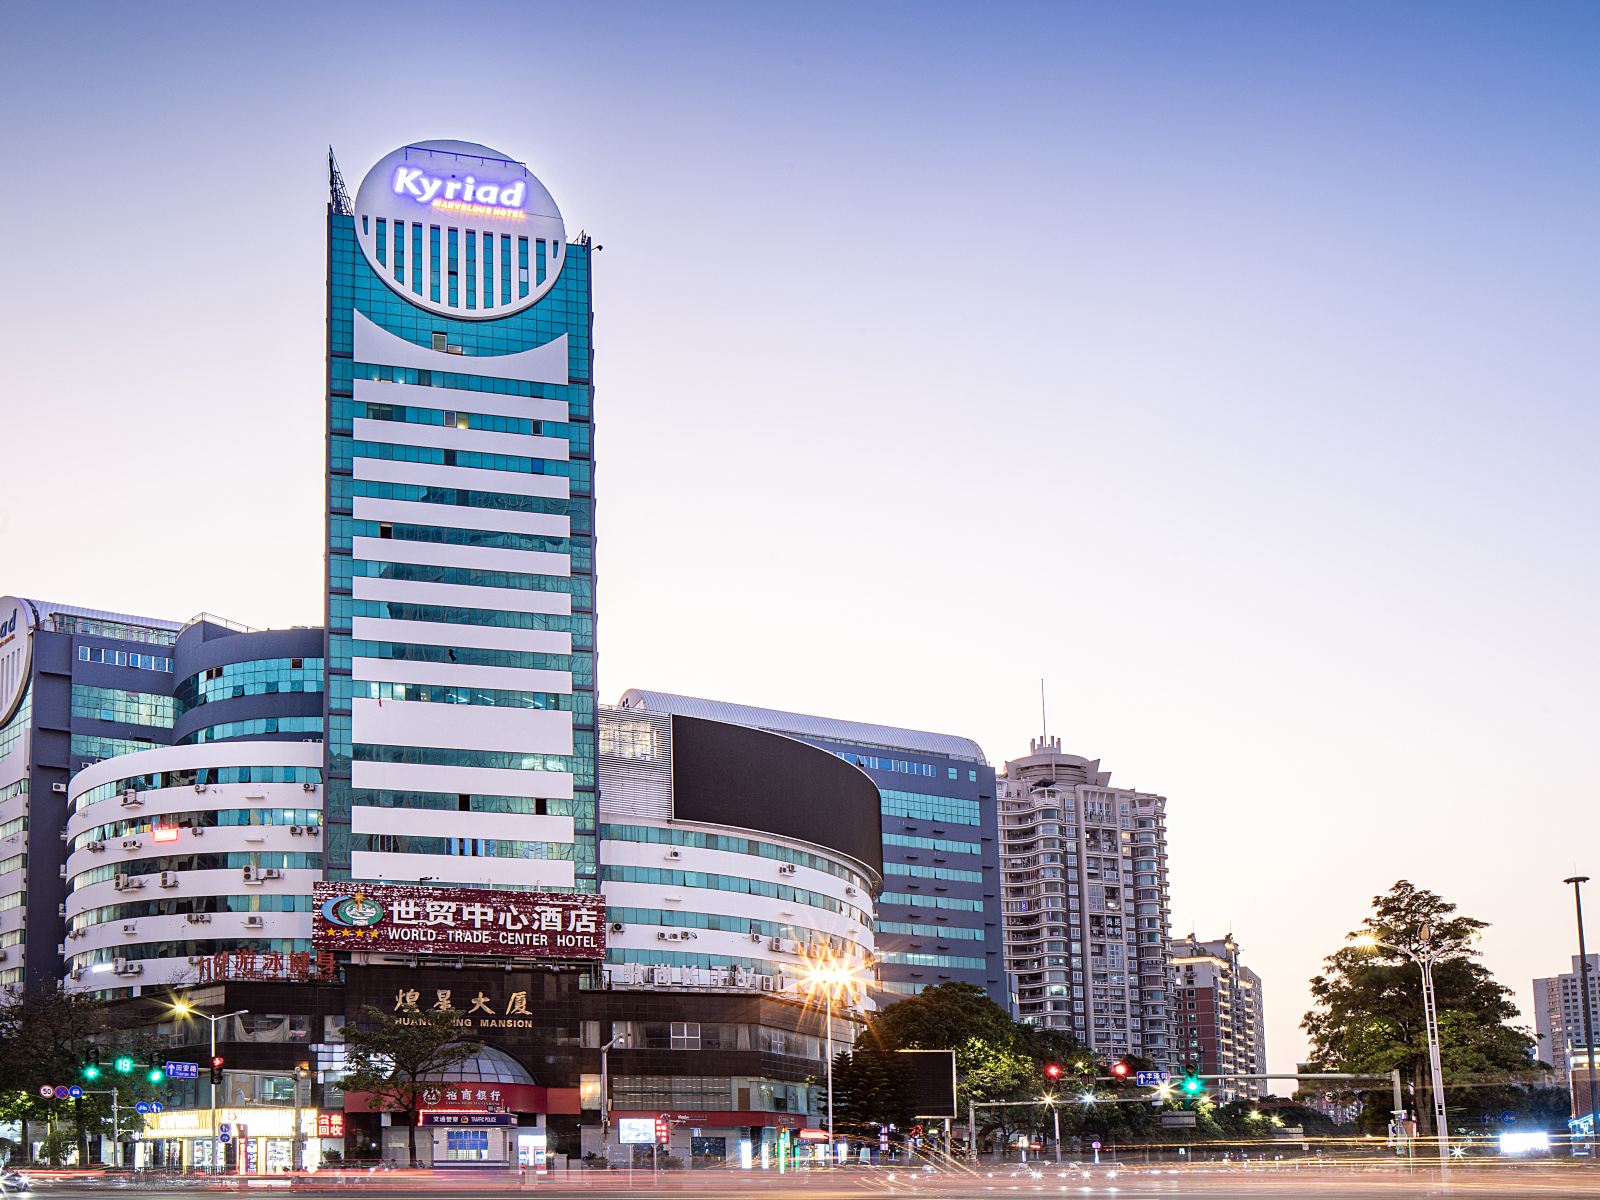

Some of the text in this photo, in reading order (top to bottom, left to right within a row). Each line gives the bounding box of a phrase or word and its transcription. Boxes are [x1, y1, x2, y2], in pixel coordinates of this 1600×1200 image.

[394, 166, 525, 208] Kyriad
[432, 199, 525, 219] MARVELOUS HOTEL
[388, 900, 598, 935] 世贸中心酒店
[387, 926, 598, 949] WORLD TRADE CENTER HOTEL
[394, 988, 534, 1016] 煌星大厦
[480, 1019, 533, 1028] MANSION
[43, 1088, 52, 1096] 50
